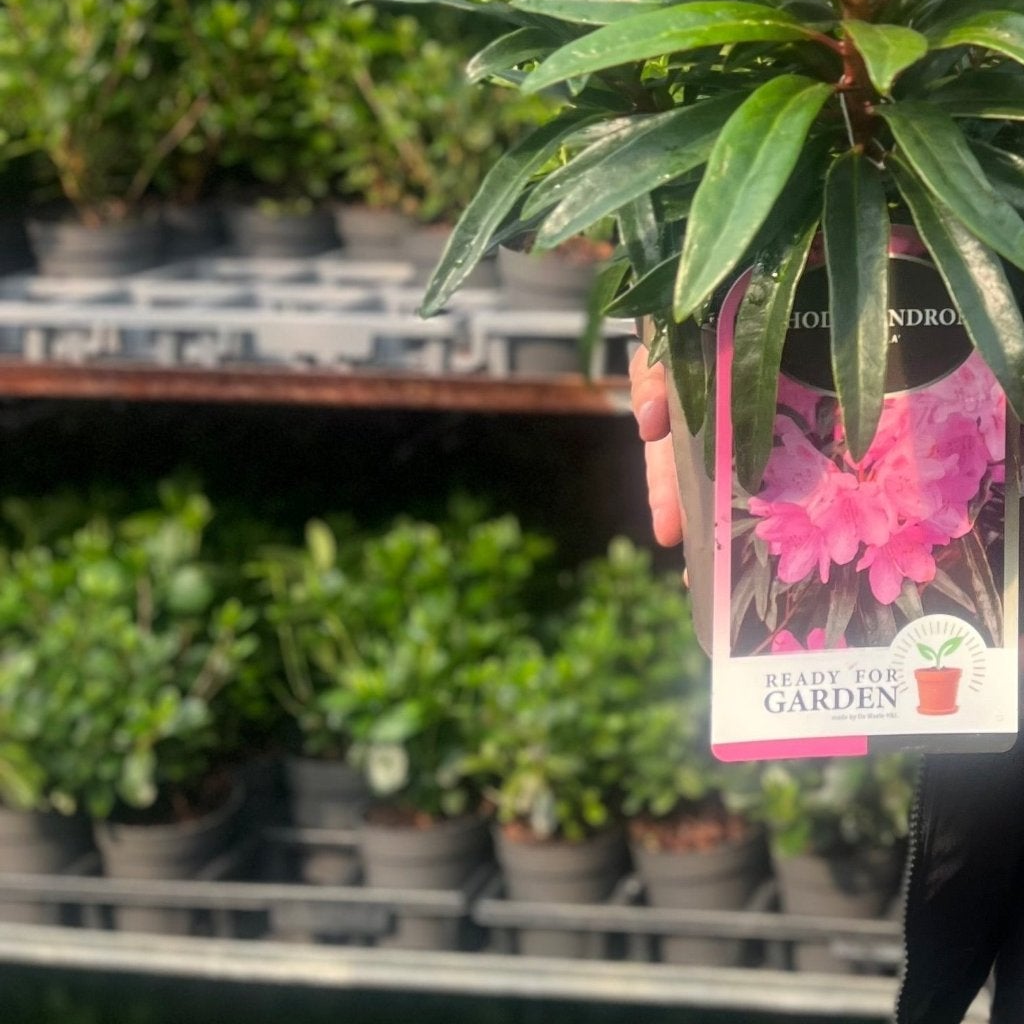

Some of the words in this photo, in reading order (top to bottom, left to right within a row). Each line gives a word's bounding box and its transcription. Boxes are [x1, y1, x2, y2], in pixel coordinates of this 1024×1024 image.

[766, 670, 840, 687] READY
[855, 668, 898, 684] FOR
[763, 686, 899, 714] GARDEN
